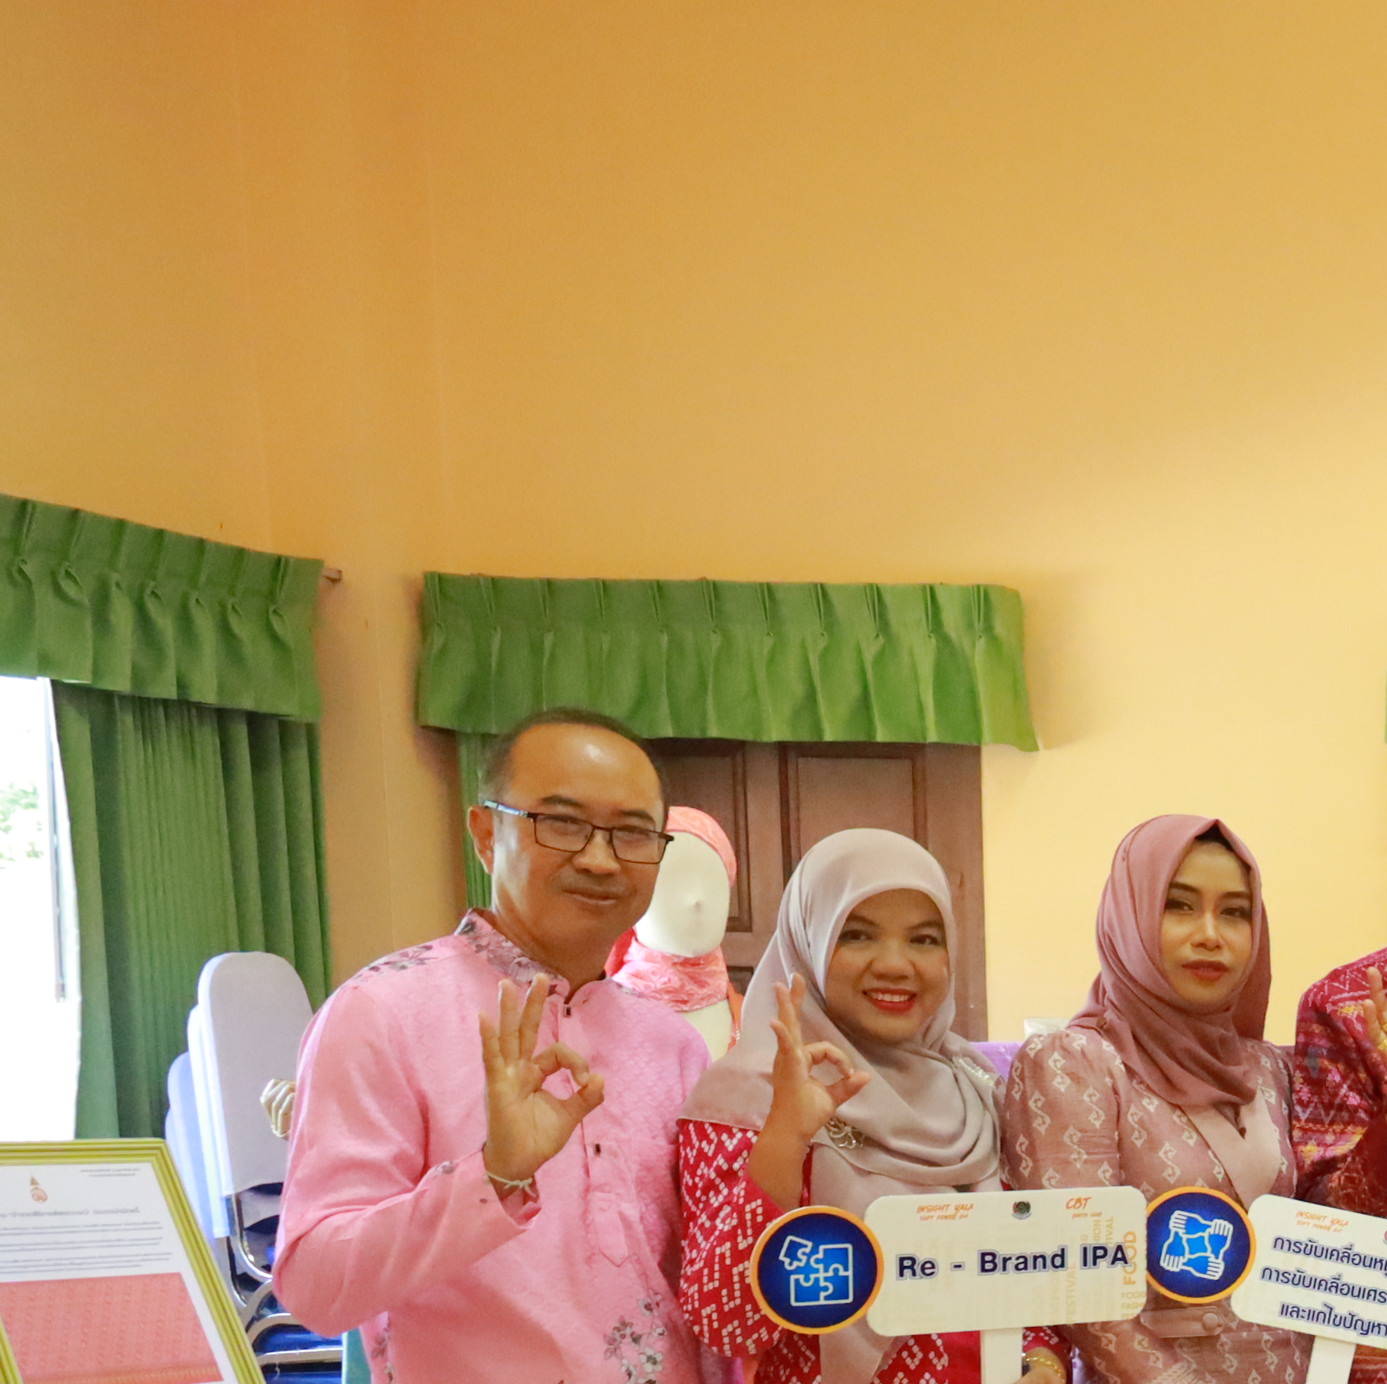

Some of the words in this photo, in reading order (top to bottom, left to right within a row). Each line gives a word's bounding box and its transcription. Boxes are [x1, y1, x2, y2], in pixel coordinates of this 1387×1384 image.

[1065, 1196, 1093, 1210] CBT
[897, 1254, 938, 1279] Re
[978, 1246, 1068, 1275] Brand
[1080, 1242, 1131, 1270] IPA
